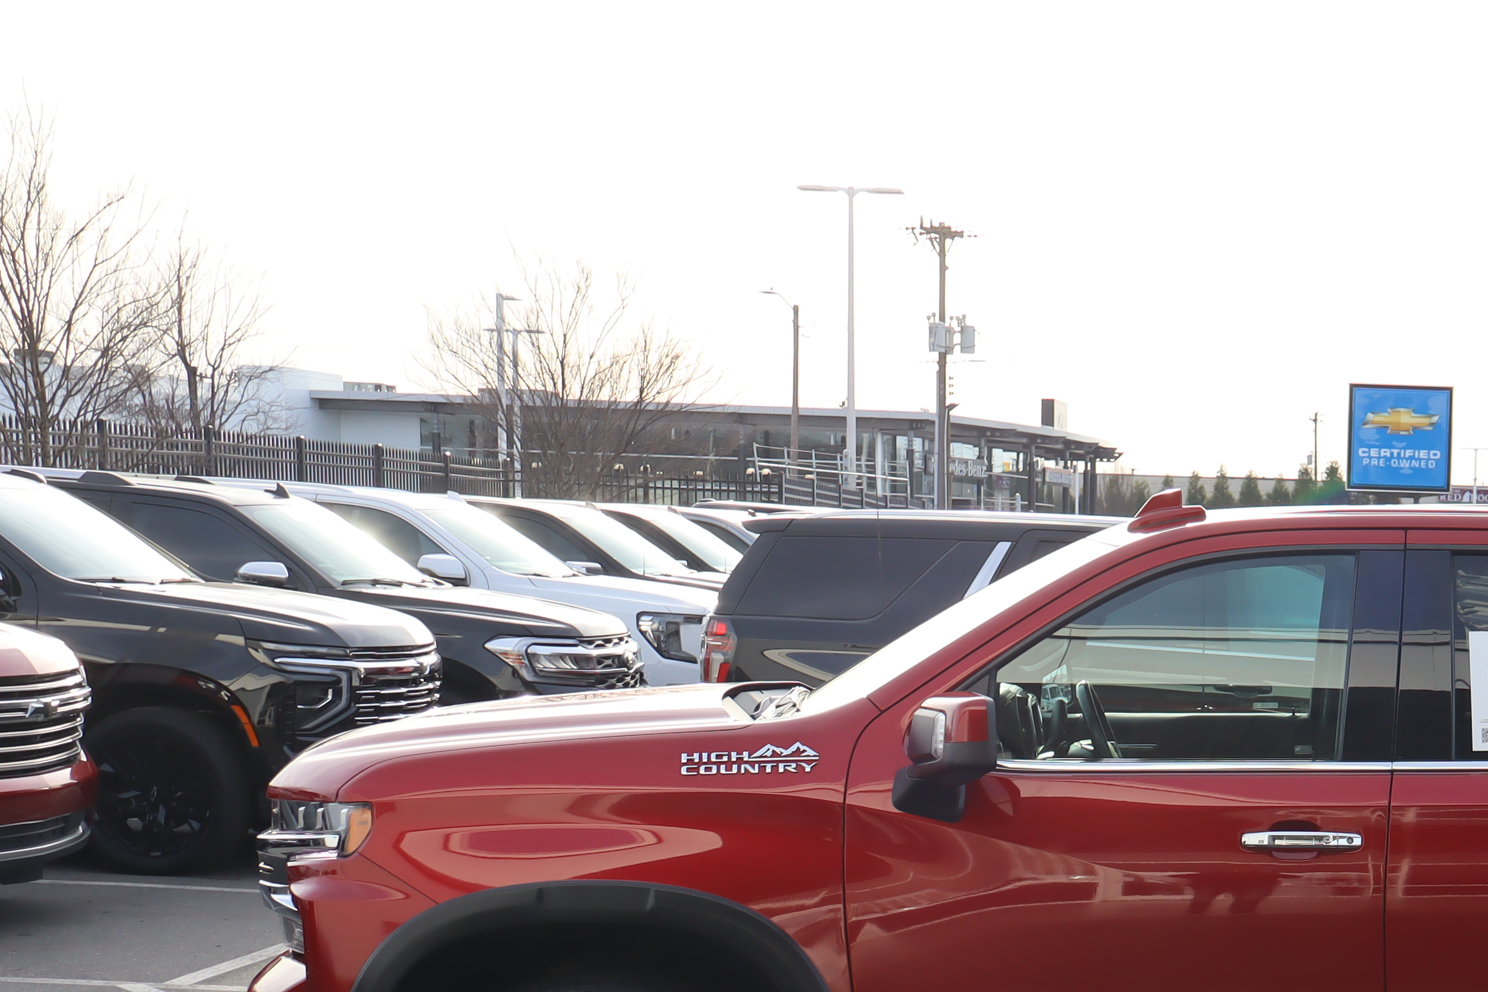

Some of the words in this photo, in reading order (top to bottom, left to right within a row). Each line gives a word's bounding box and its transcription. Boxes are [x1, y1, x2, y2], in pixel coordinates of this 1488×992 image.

[1358, 448, 1441, 459] CERTIFIED
[1363, 458, 1436, 469] PRE-OWNED
[681, 751, 750, 763] HIGH
[680, 762, 818, 776] COUNTRY
